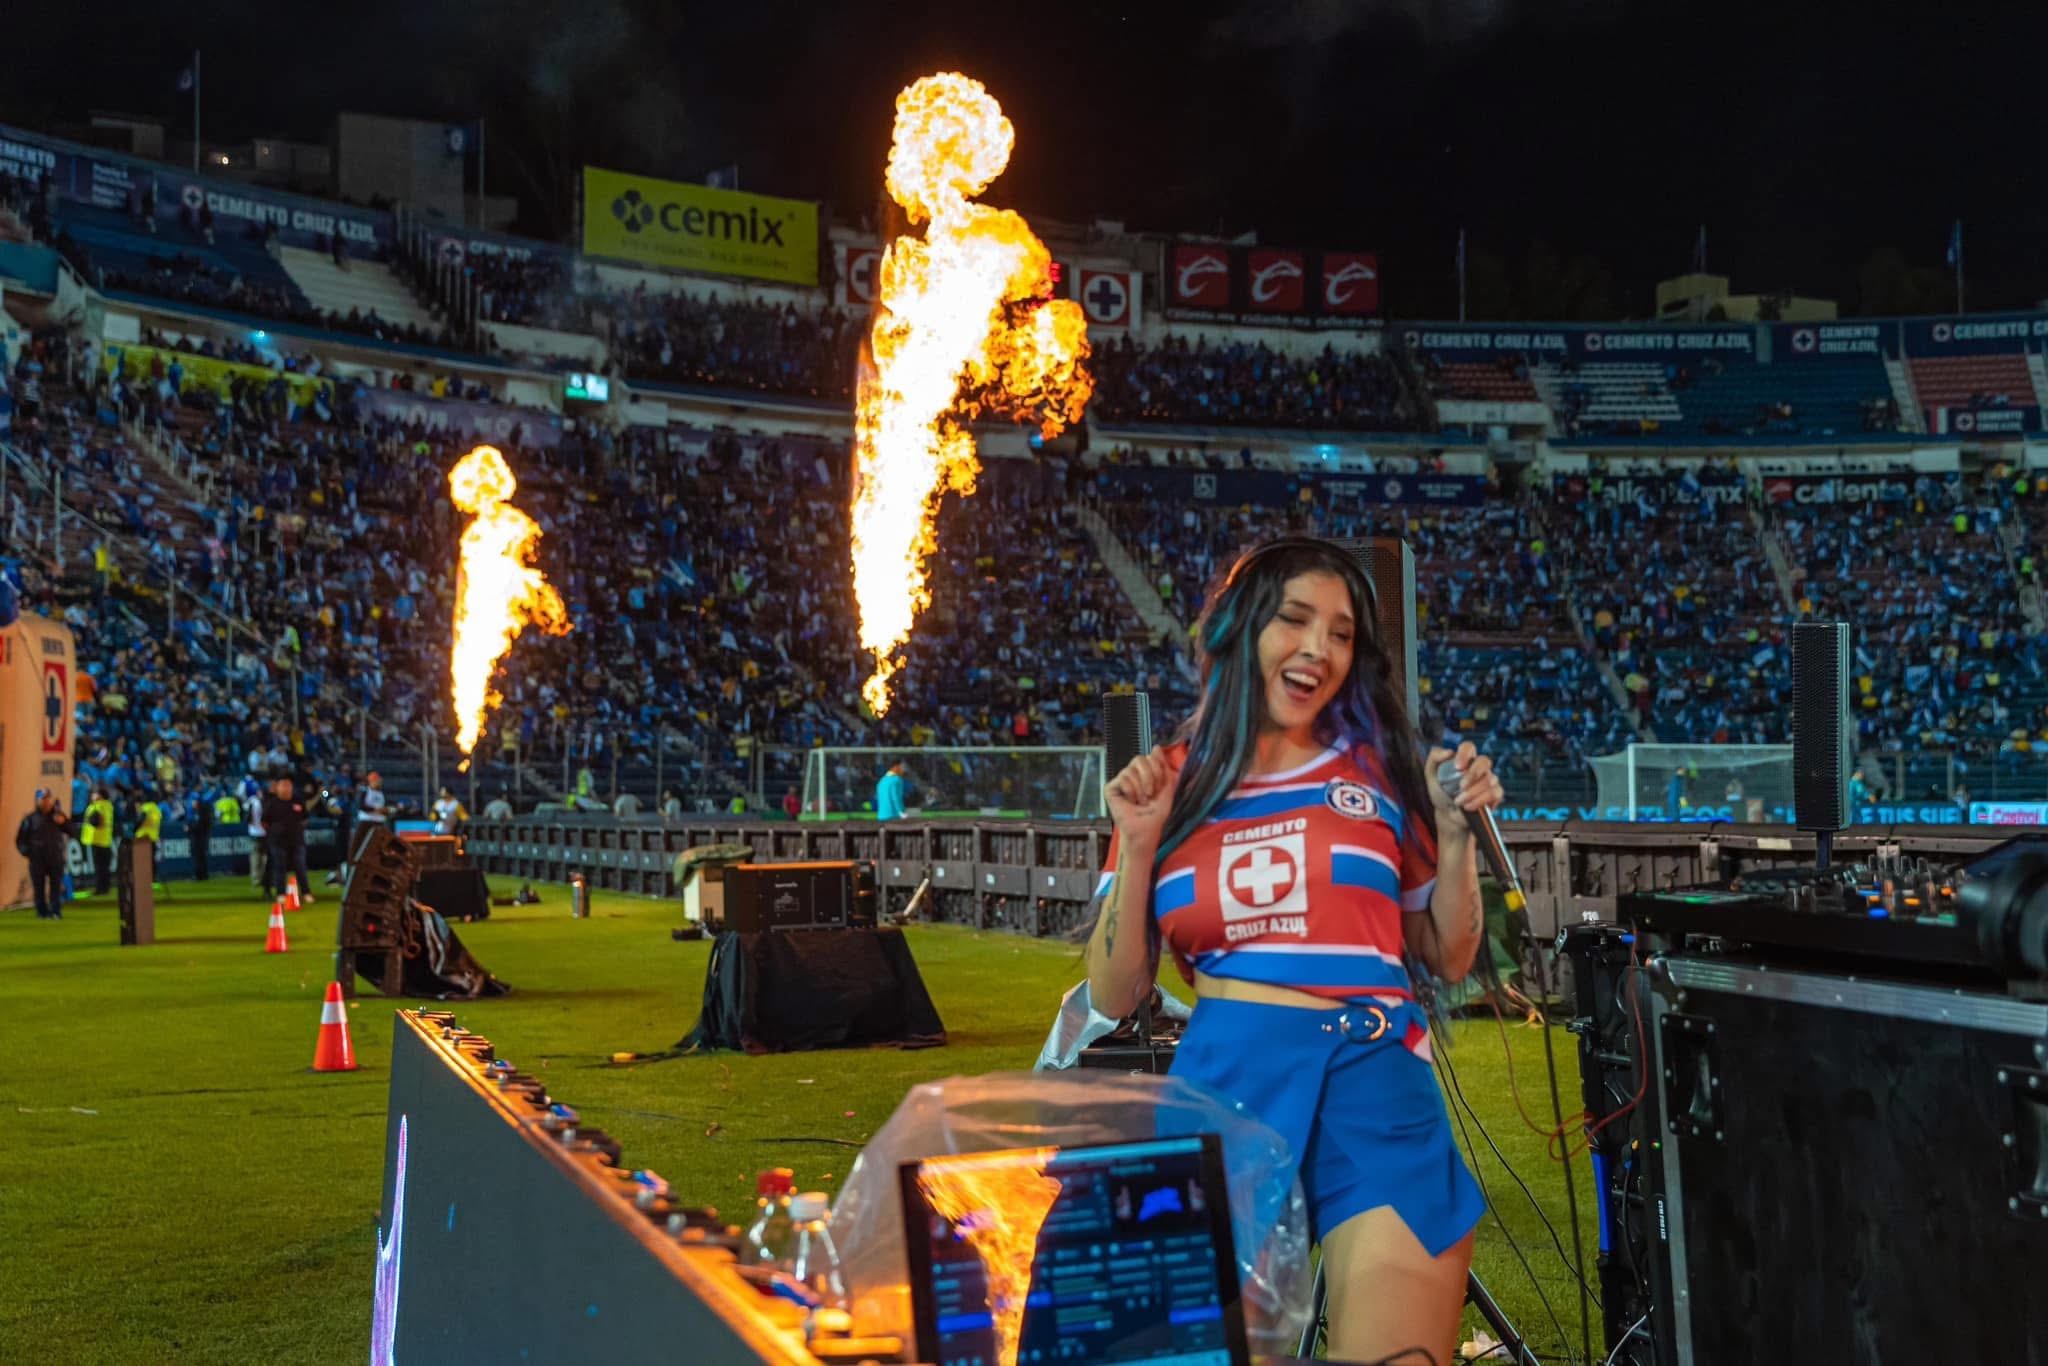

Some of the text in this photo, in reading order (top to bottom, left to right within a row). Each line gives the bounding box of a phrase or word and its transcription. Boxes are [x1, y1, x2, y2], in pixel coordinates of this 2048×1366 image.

[206, 191, 288, 227] CEMENTO
[291, 210, 335, 236] CRUZ
[659, 202, 783, 247] cemix
[1819, 325, 1880, 338] CEMENTO
[1953, 320, 2030, 341] CEMENTO
[1422, 332, 1566, 352] CEMENTO CRUZ AZUL
[1603, 333, 1750, 353] CEMENTO CRUZ AZUL
[1819, 340, 1879, 354] CRUZ AZUL
[1223, 817, 1306, 844] CEMENTO
[1225, 916, 1308, 942] CRUZ AZUL
